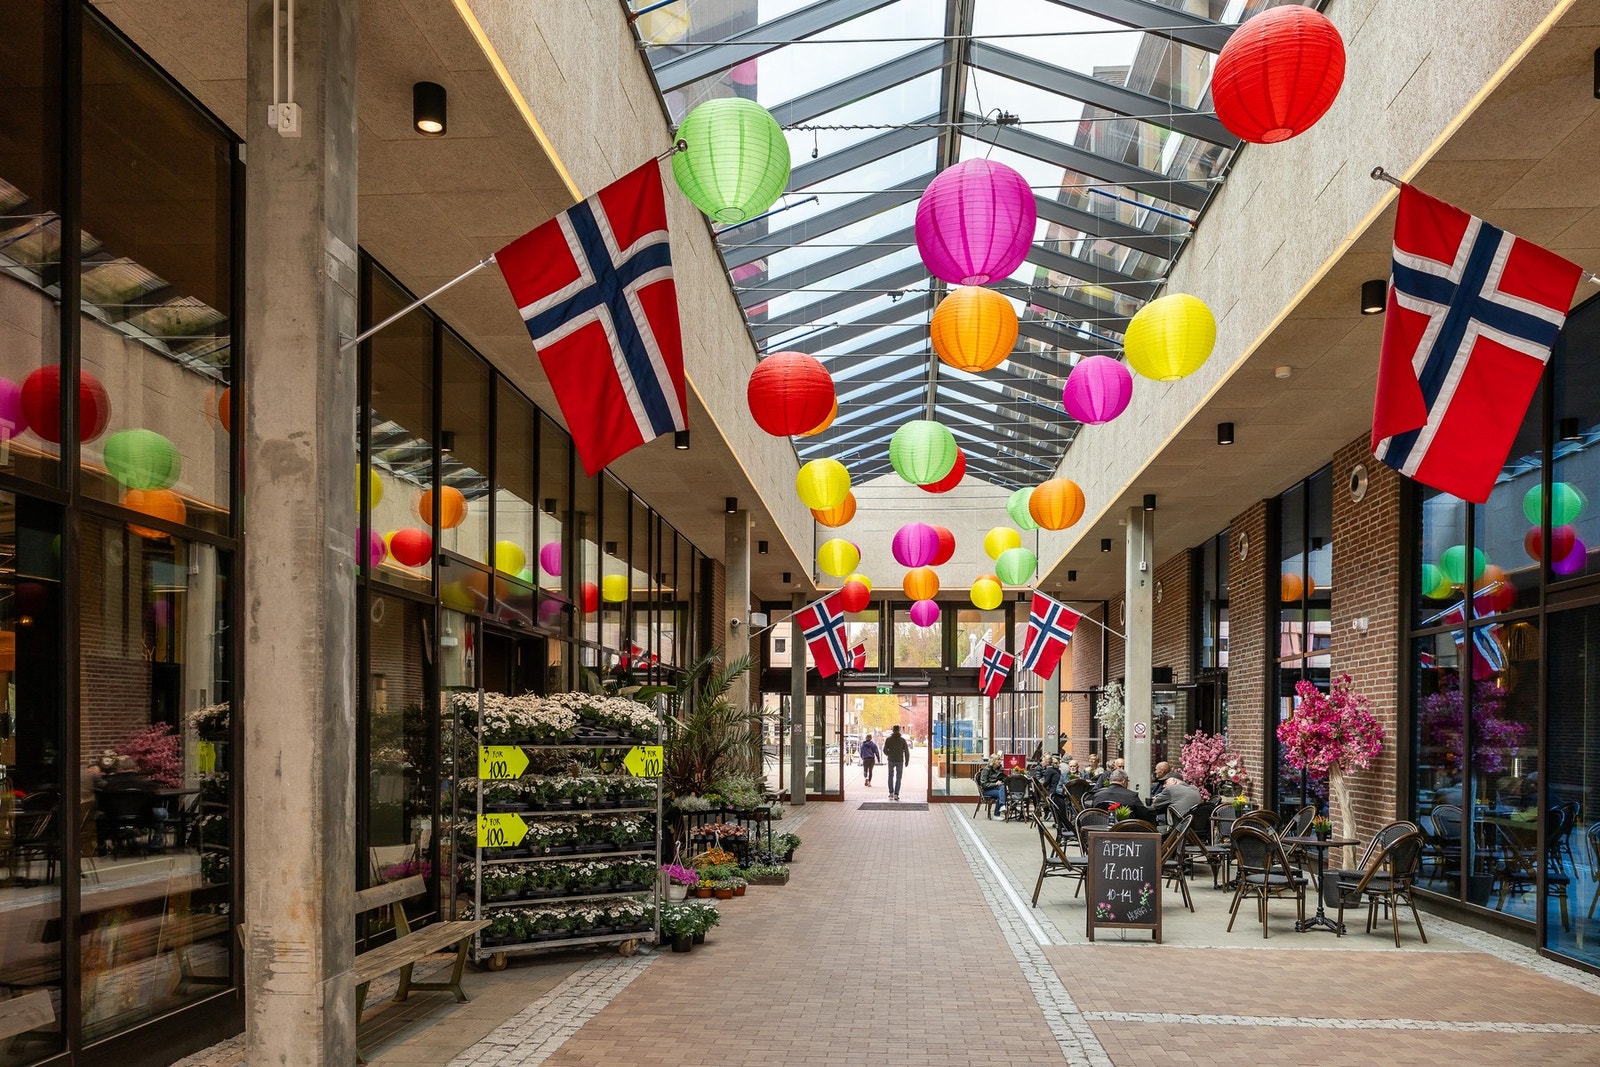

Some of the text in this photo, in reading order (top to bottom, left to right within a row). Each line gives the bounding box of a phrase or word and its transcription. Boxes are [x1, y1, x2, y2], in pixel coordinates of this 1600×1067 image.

[483, 746, 504, 763] 3 FOR
[640, 746, 657, 762] 3 FOR
[480, 813, 501, 830] 3 FOR
[1102, 840, 1142, 857] ÅPENT
[1102, 862, 1144, 881] 17. mai
[1106, 888, 1133, 903] 10-14
